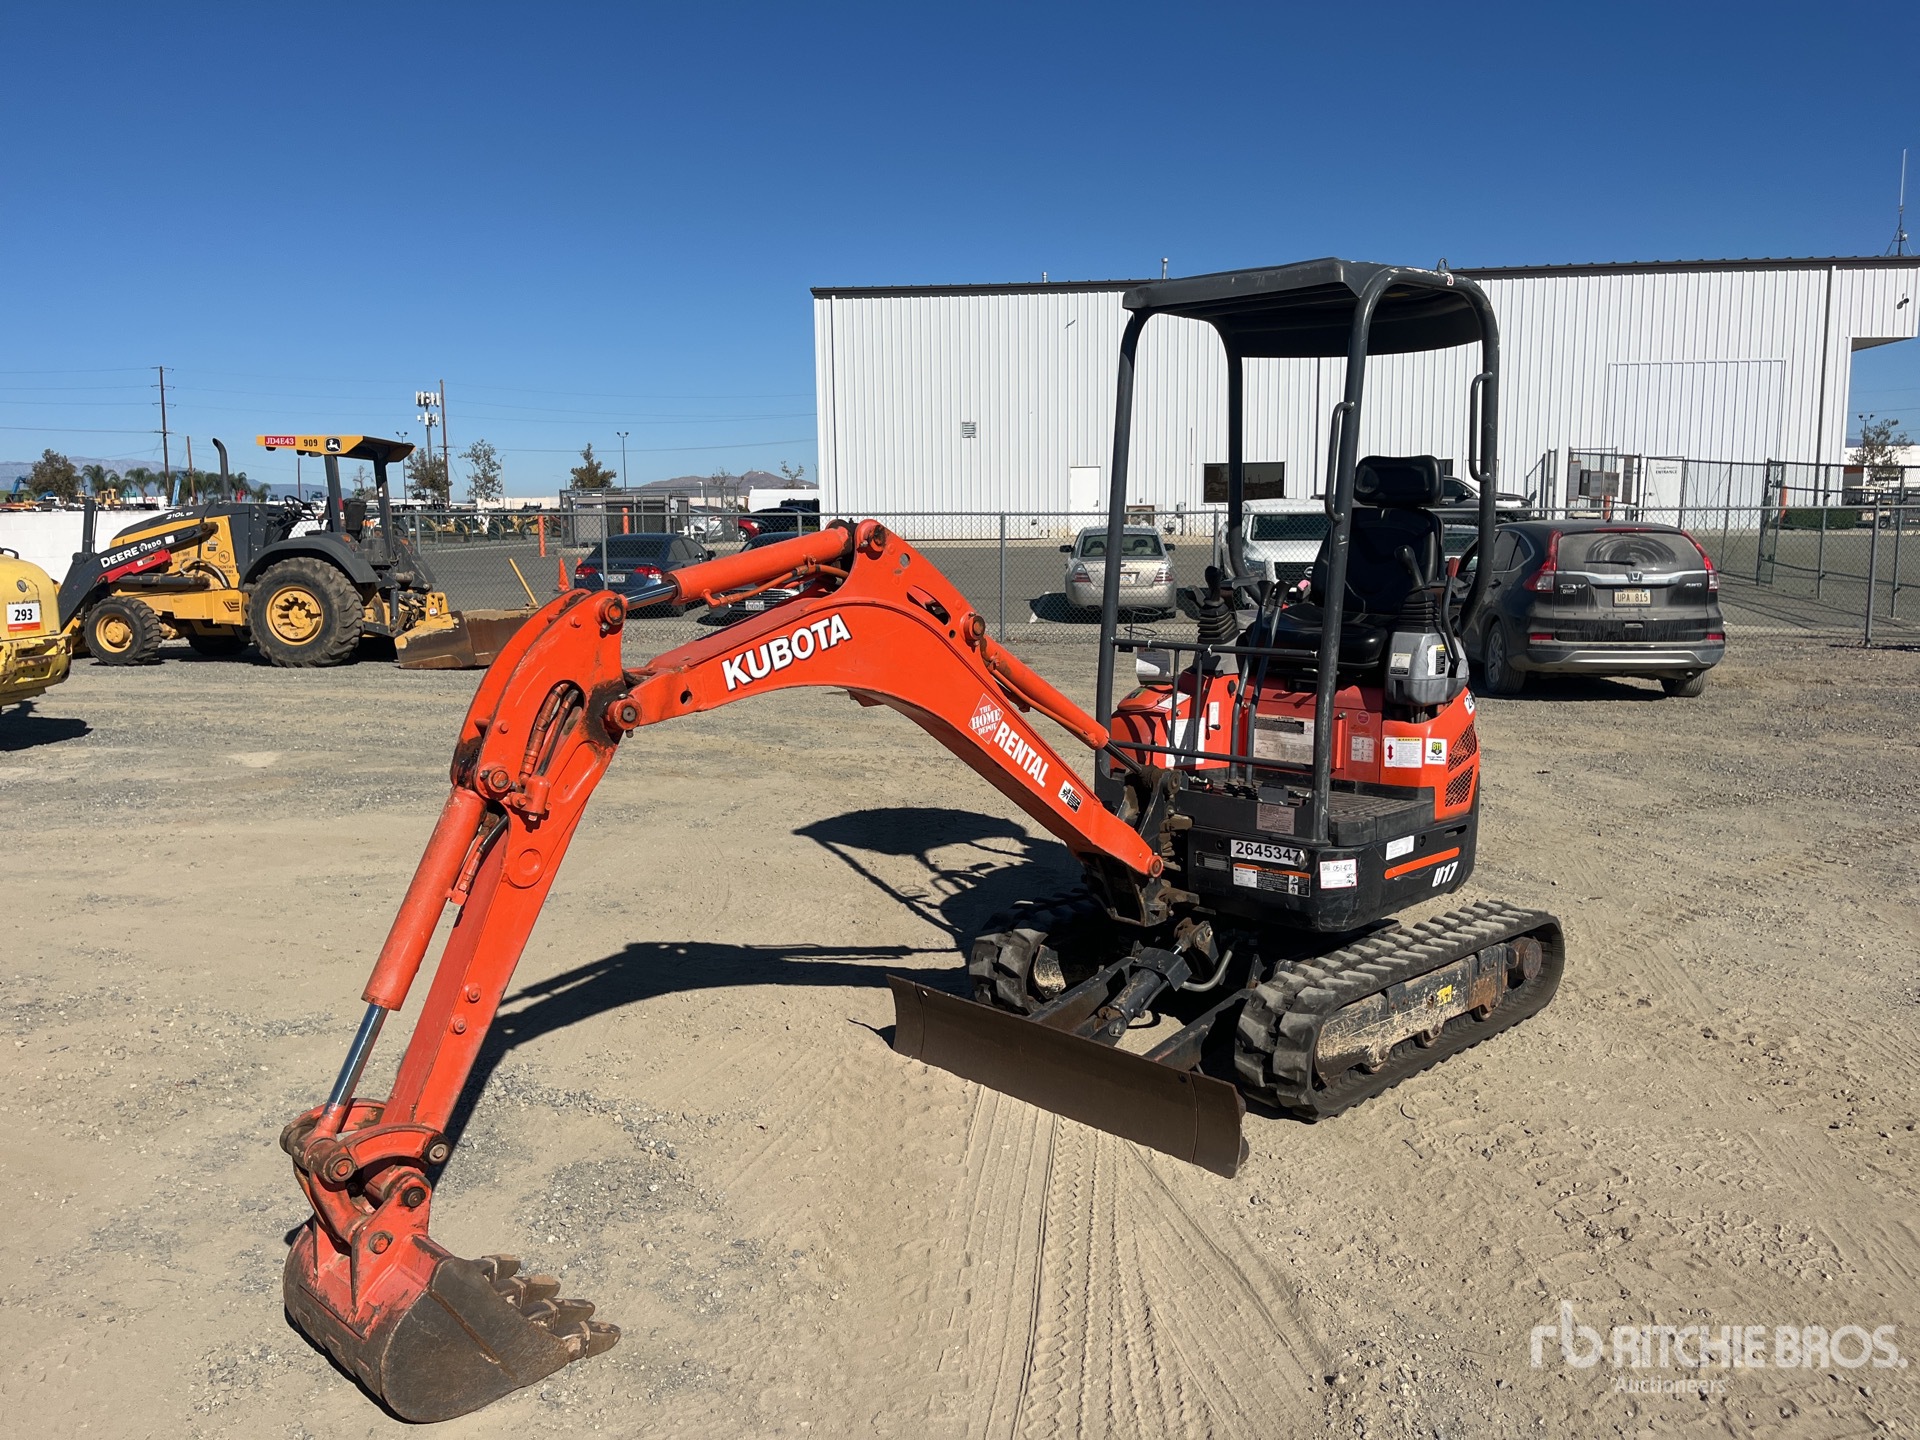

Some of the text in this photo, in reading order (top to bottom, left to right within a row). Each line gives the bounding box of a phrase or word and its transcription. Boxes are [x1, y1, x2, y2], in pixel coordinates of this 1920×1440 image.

[266, 437, 295, 445] JD4E43
[303, 438, 318, 447] 909
[101, 546, 139, 568] DEERE
[1617, 593, 1648, 602] UPA 815
[14, 608, 33, 621] 293
[721, 613, 852, 692] KUBOTA
[979, 704, 991, 713] THE
[971, 708, 1001, 730] HOME
[978, 722, 997, 735] DEPOT
[993, 721, 1049, 788] RENTAL
[1235, 841, 1301, 862] 2645347
[1432, 861, 1458, 887] U17
